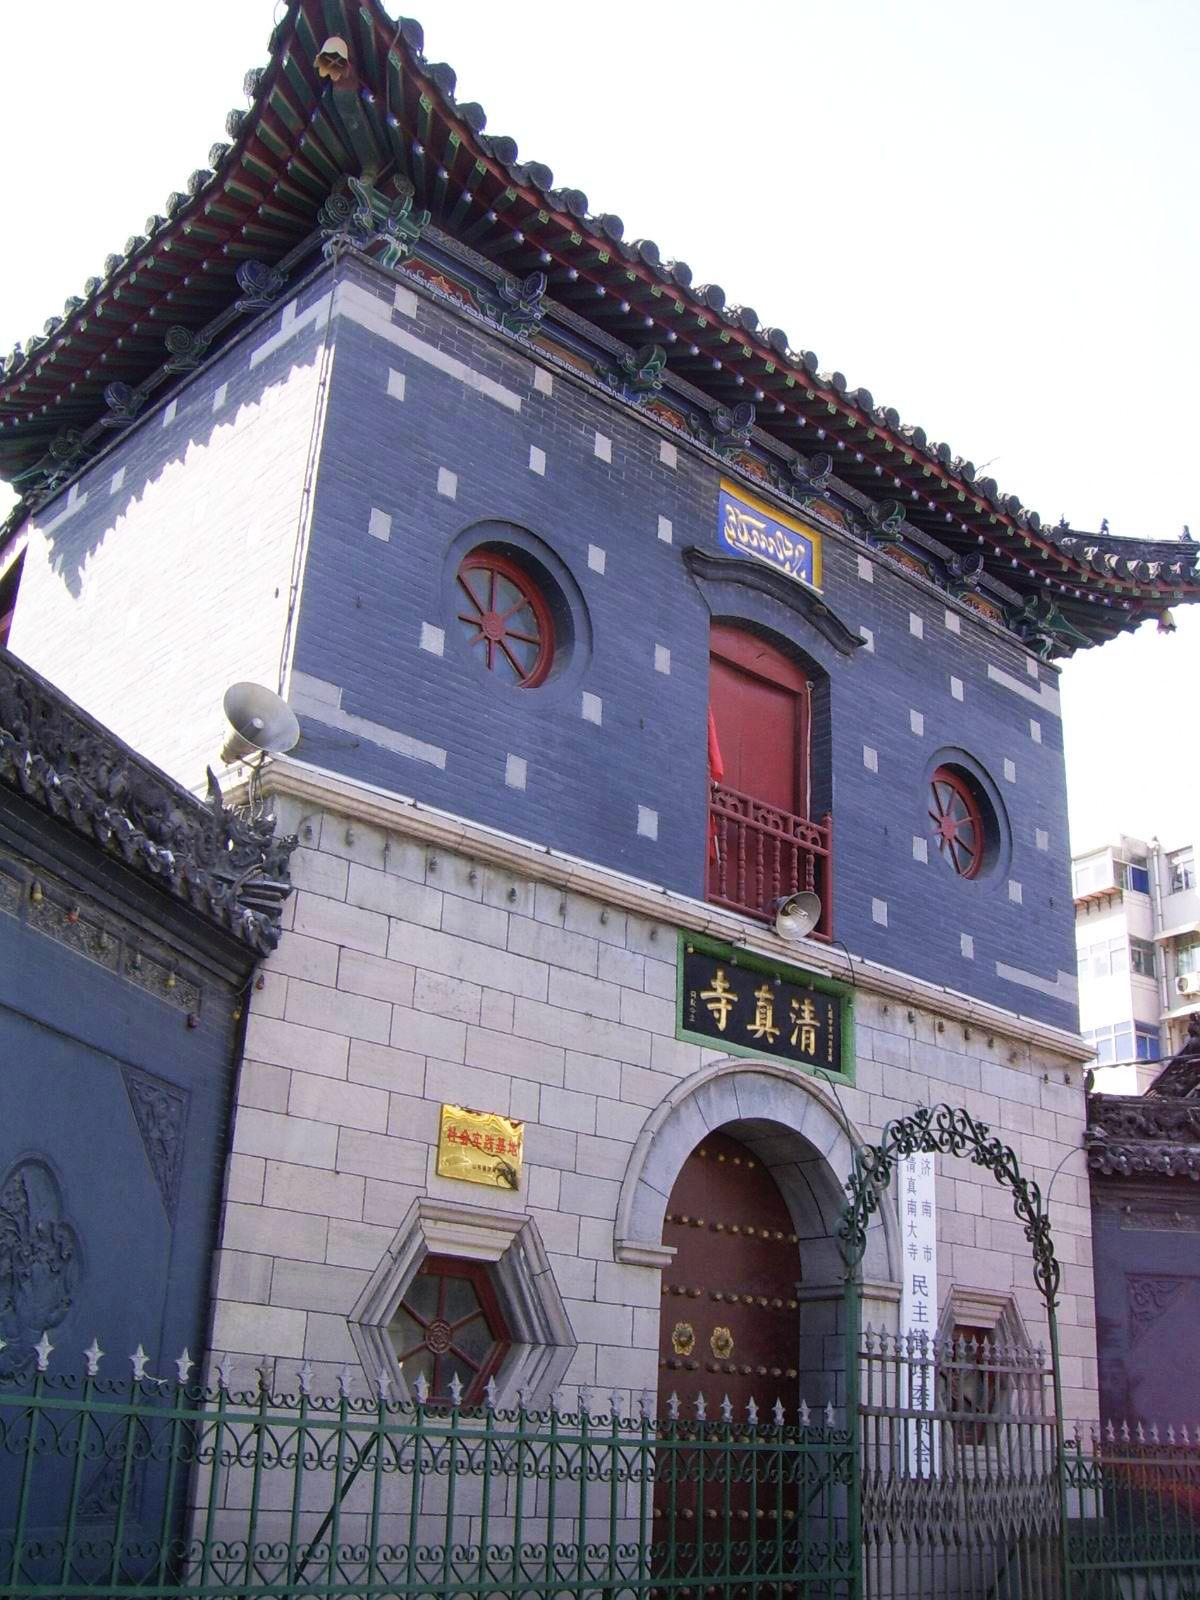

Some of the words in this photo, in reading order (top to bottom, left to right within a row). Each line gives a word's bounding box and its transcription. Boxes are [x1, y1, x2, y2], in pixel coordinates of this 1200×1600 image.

[905, 1155, 919, 1262] 清真南大寺
[920, 1157, 933, 1264] 济南市
